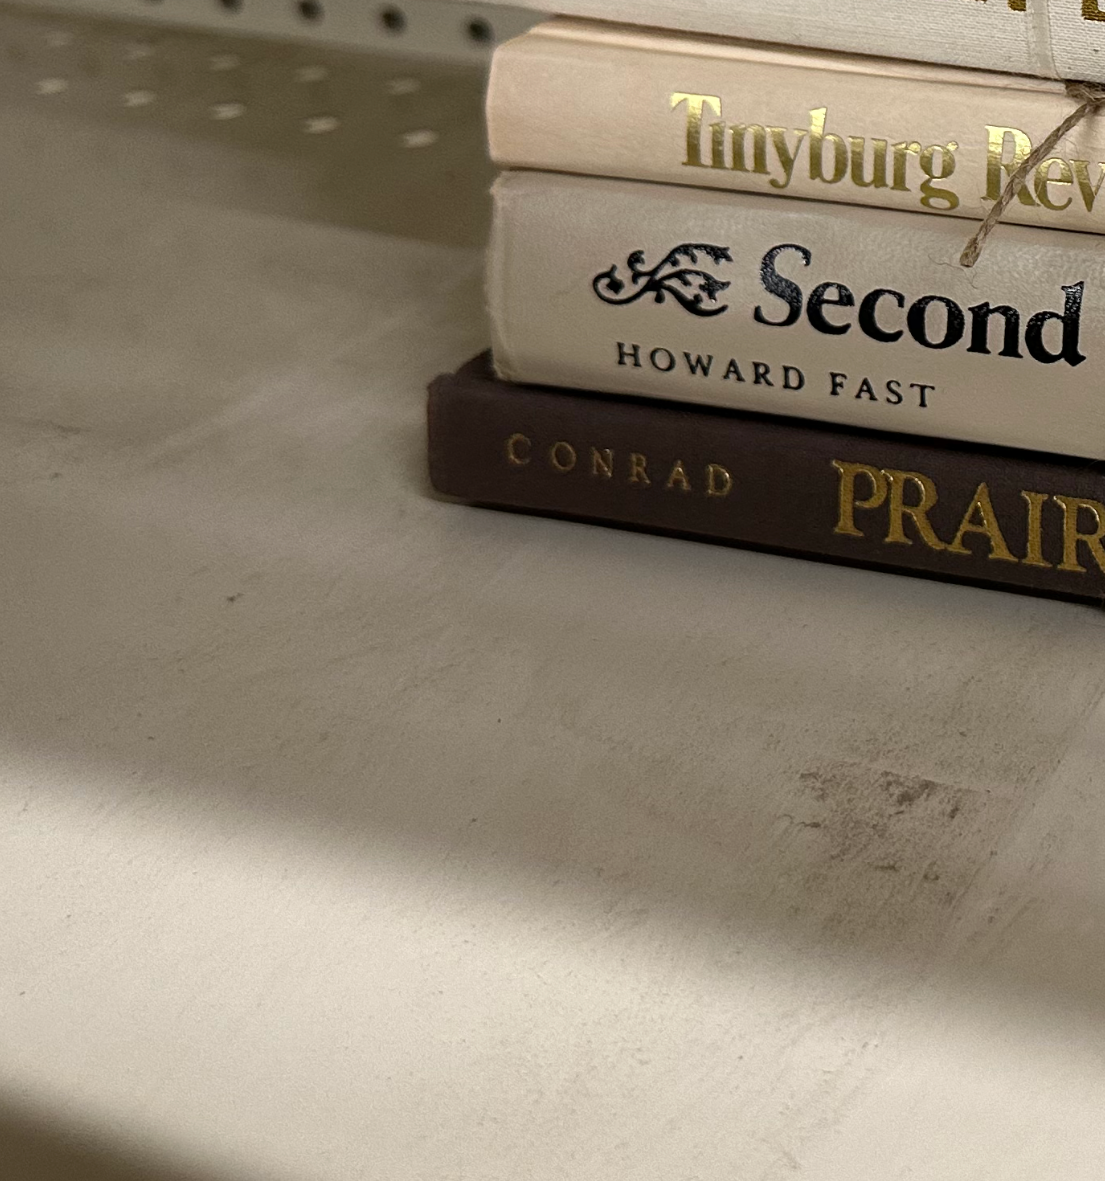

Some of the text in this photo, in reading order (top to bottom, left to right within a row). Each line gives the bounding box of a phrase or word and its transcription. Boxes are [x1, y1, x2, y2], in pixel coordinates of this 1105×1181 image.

[669, 90, 960, 212] Tinyburg
[752, 242, 1087, 368] Second
[615, 341, 937, 410] HOWARD FAST
[504, 431, 735, 499] CONRAD
